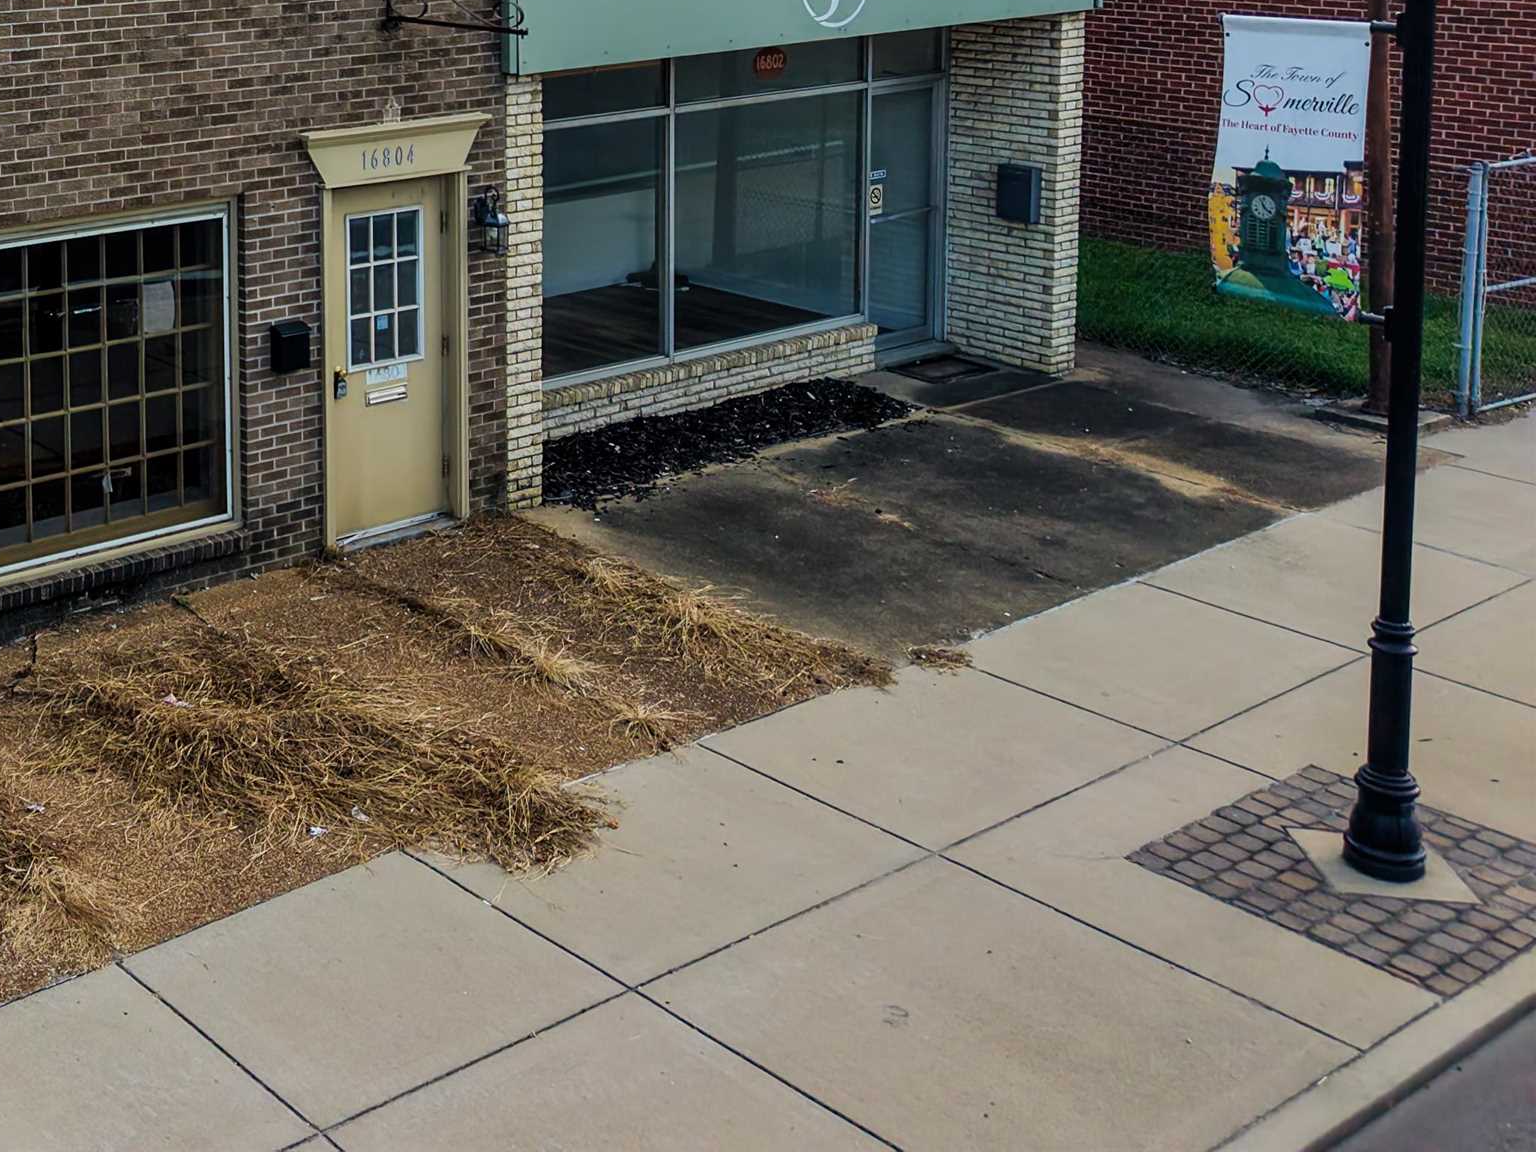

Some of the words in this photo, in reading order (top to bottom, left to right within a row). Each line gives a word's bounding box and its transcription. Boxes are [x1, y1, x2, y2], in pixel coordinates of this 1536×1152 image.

[756, 53, 785, 72] 16802
[1250, 64, 1279, 79] The
[1280, 66, 1321, 84] Town
[1324, 71, 1347, 89] of
[1221, 118, 1240, 129] The
[1240, 120, 1268, 132] Heart
[1270, 123, 1282, 133] of
[1283, 125, 1319, 137] Fayette
[1321, 128, 1359, 142] County
[362, 143, 414, 170] 16804
